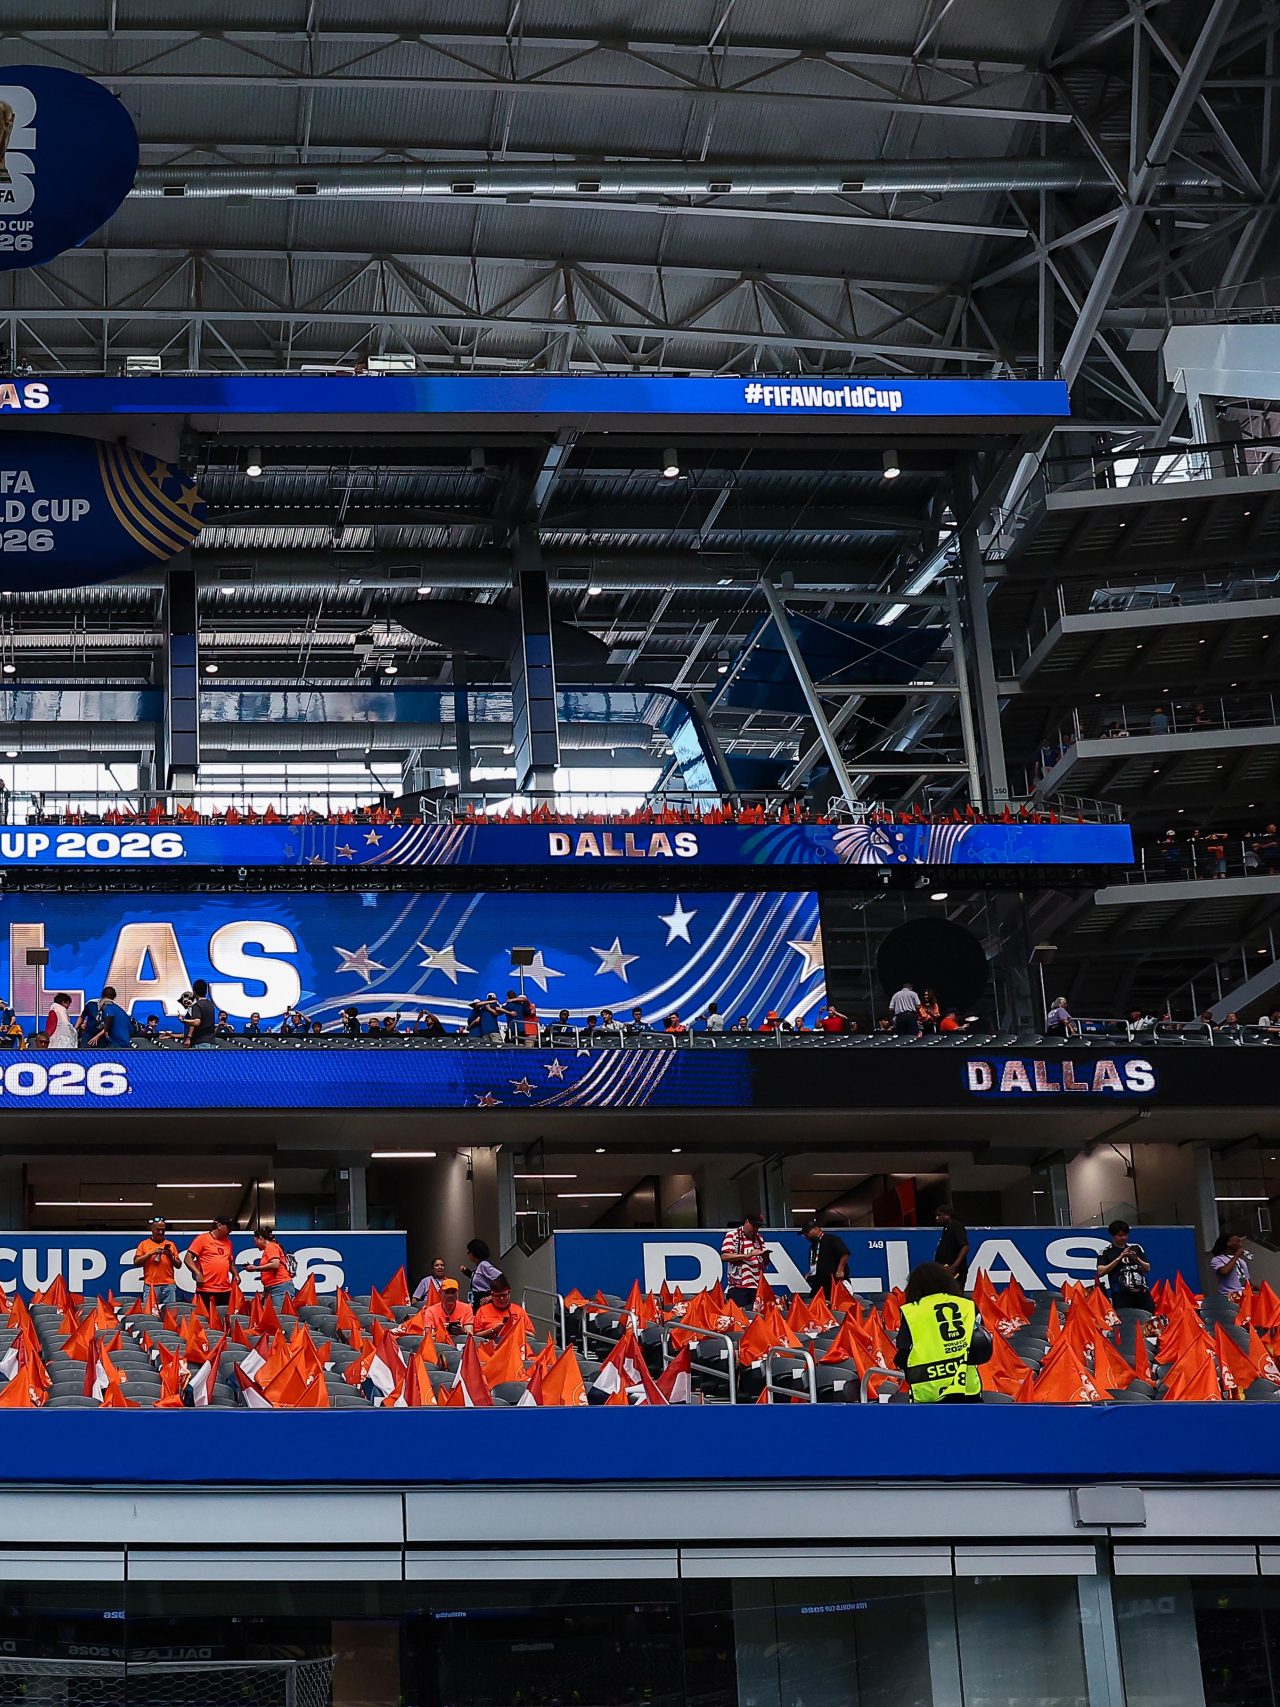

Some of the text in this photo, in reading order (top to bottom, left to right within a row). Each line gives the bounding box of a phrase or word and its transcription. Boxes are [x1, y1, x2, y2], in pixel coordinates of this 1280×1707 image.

[9, 220, 34, 232] CUP
[745, 384, 902, 411] #FIFAWorldCup
[32, 499, 90, 522] CUP
[56, 832, 183, 859] 2026
[548, 832, 700, 858] DALLAS
[967, 1060, 1156, 1091] DALLAS
[868, 1240, 884, 1249] 149
[120, 1247, 345, 1293] 226
[945, 1342, 968, 1354] 2026
